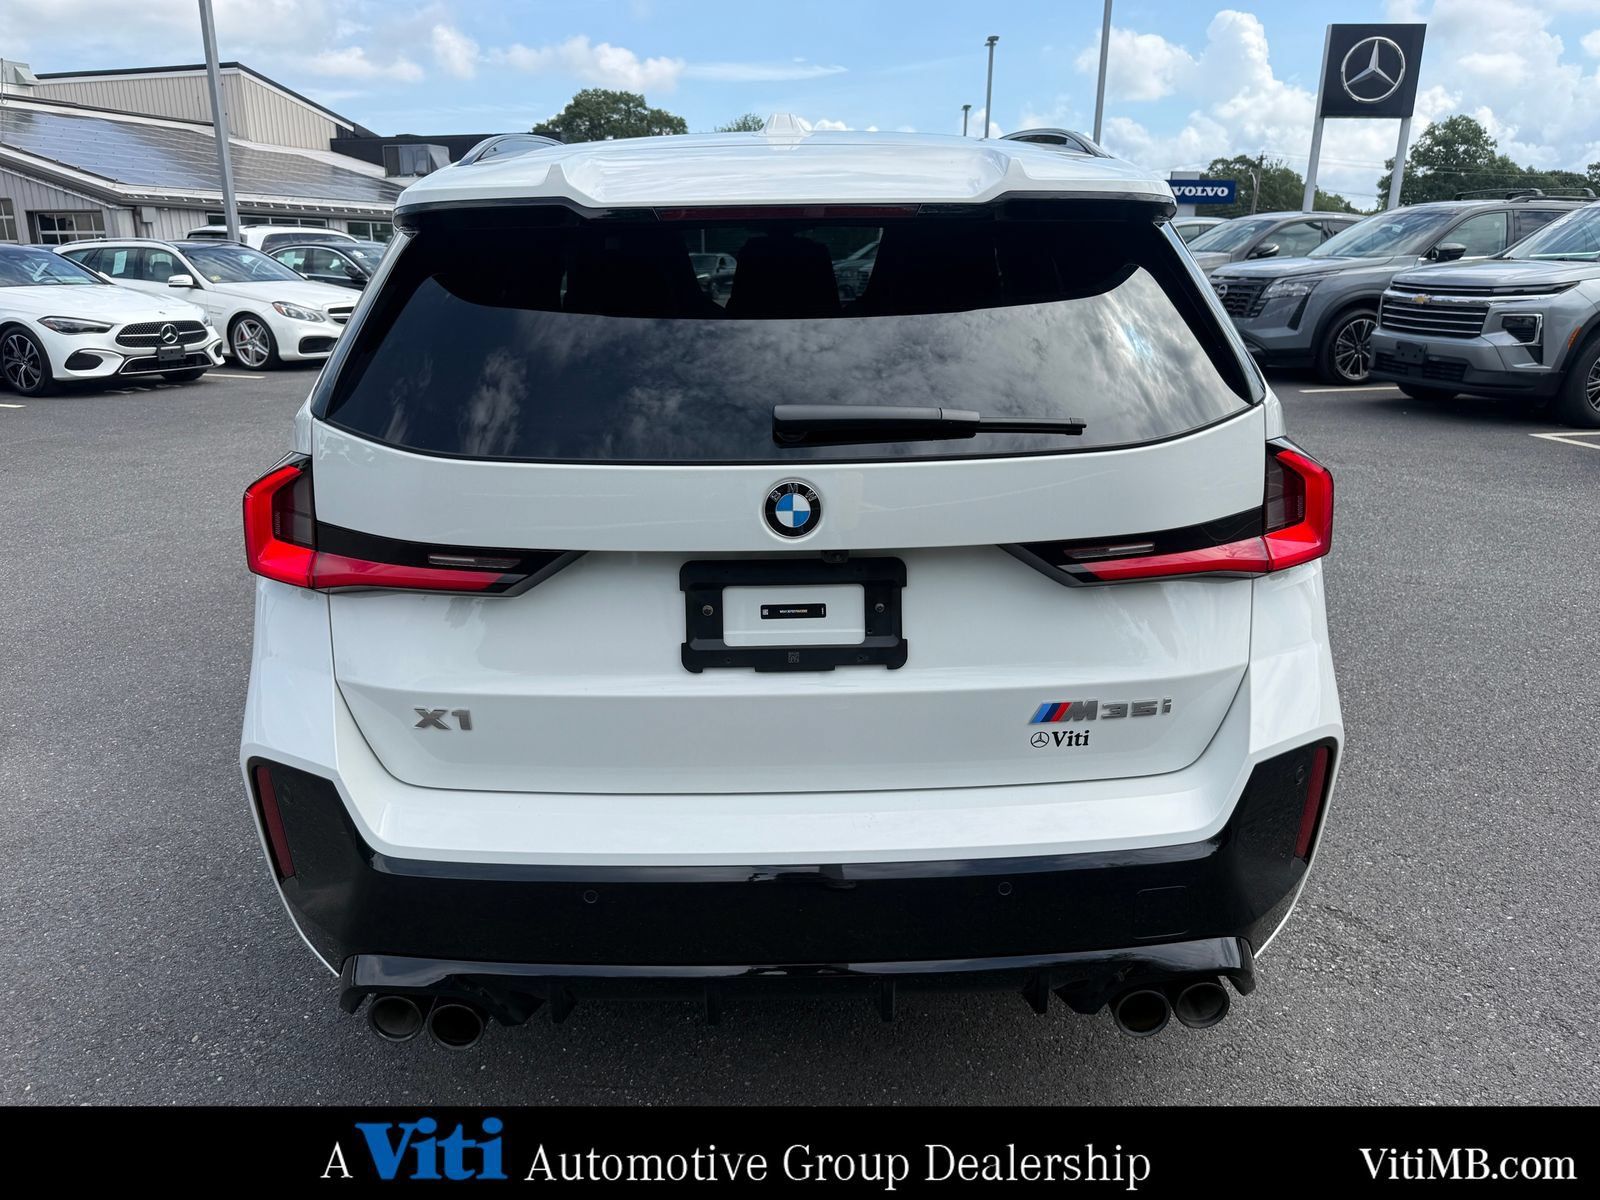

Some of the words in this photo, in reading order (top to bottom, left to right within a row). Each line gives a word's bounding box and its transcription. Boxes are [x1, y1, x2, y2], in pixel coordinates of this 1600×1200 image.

[1171, 186, 1229, 197] VOLVO
[770, 482, 816, 503] BMW
[413, 707, 473, 731] X1
[1063, 698, 1172, 722] M35i
[1052, 730, 1090, 747] Viti
